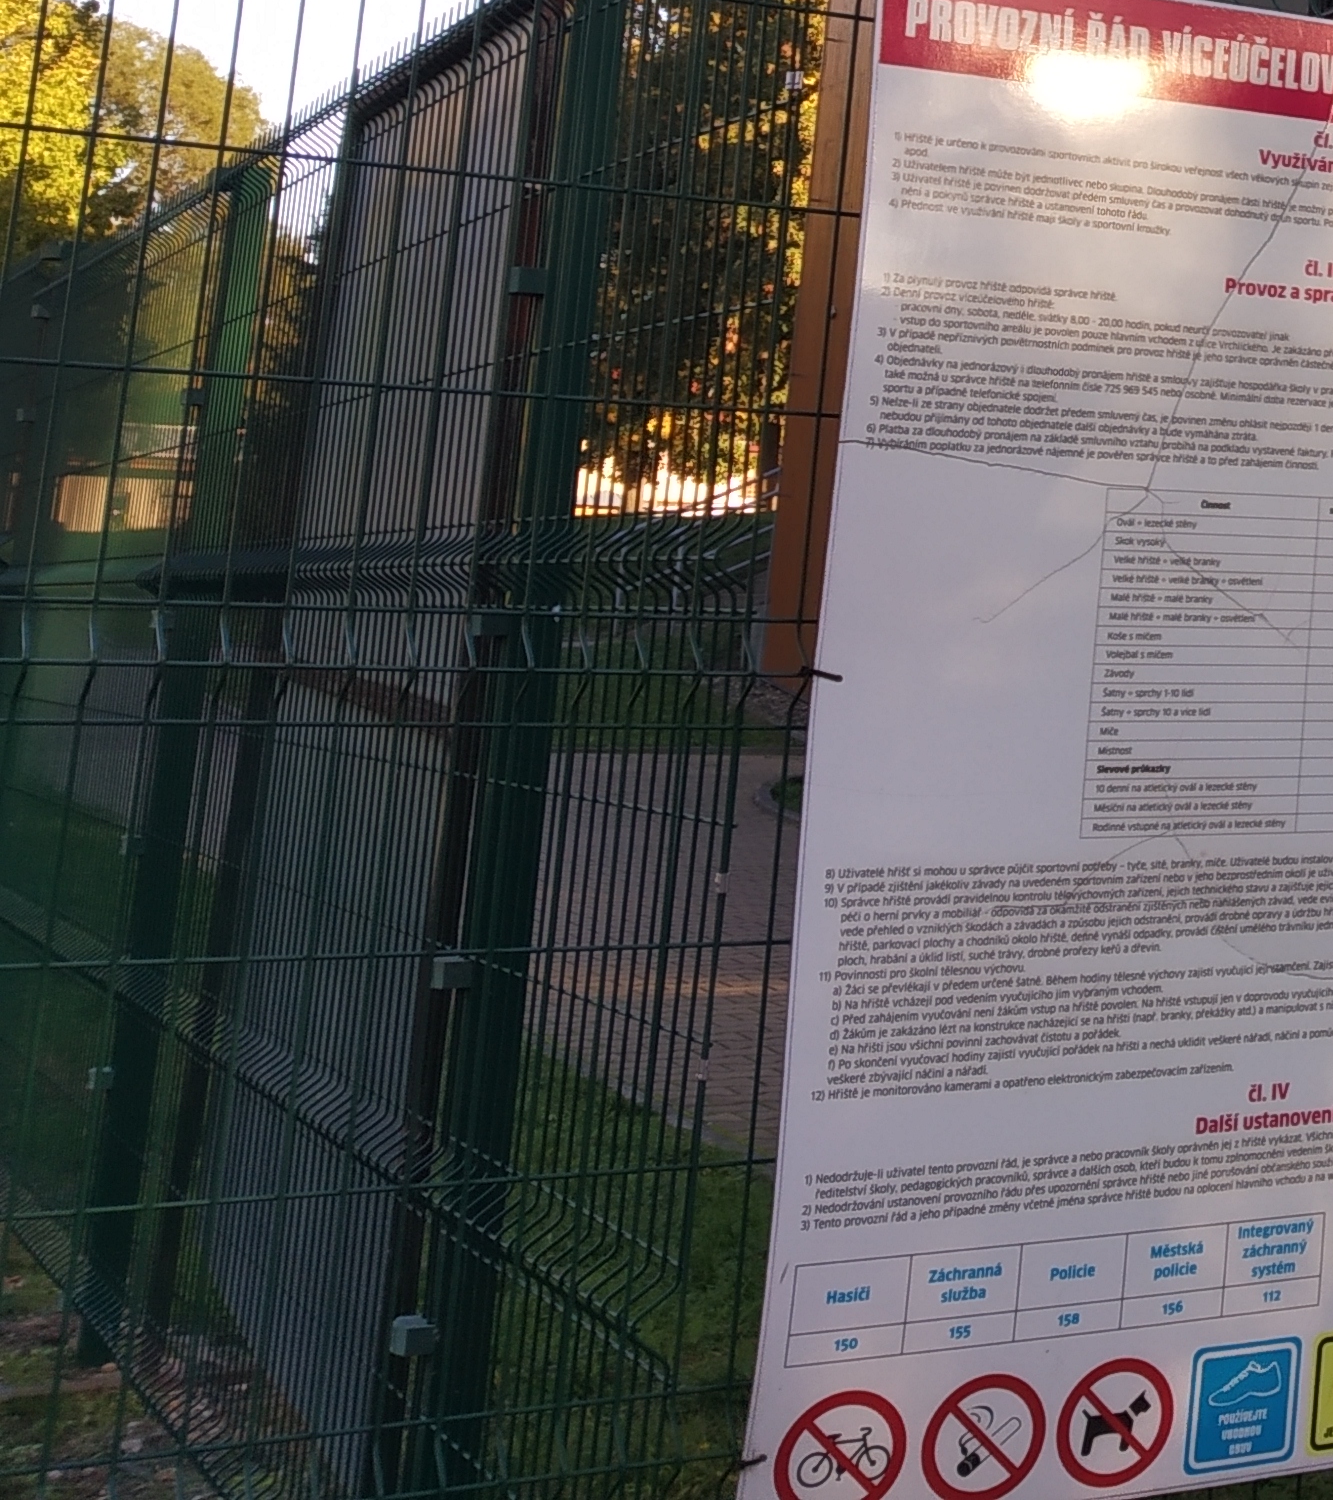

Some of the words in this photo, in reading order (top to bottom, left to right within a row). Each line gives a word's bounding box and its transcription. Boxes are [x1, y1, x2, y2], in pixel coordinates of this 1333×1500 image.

[1087, 11, 1151, 58] ŘÁD
[1314, 132, 1333, 149] čl.
[1304, 258, 1323, 277] čl.
[1224, 278, 1286, 298] Provoz
[1289, 286, 1299, 299] a
[1103, 668, 1134, 679] Závody
[819, 971, 831, 982] 11)
[834, 969, 886, 980] Povinnosti
[889, 969, 906, 979] pro
[909, 965, 938, 978] školní
[940, 965, 981, 976] tělesnou
[983, 964, 1025, 975] výchovu.
[831, 999, 841, 1011] b)
[844, 999, 858, 1009] Na
[860, 997, 889, 1008] hřiště
[892, 995, 932, 1007] vcházejí
[934, 994, 953, 1006] pod
[955, 992, 997, 1004] vedením
[999, 989, 1053, 1003] vyučujícího
[1054, 988, 1070, 1000] jím
[1072, 986, 1118, 999] vybraným
[1120, 984, 1163, 995] vchodem.
[828, 1044, 838, 1056] e)
[840, 1044, 855, 1054] Na
[857, 1041, 883, 1053] hřišti
[885, 1042, 906, 1053] jsou
[909, 1038, 943, 1050] všichni
[945, 1035, 982, 1049] povinni
[984, 1033, 1038, 1046] zachovávat
[1040, 1032, 1071, 1042] čistotu
[1073, 1032, 1079, 1040] a
[1081, 1027, 1120, 1040] pořádek.
[811, 1089, 825, 1101] 12)
[827, 1087, 858, 1099] Hřiště
[859, 1087, 870, 1099] je
[872, 1082, 941, 1096] monitorováno
[943, 1078, 991, 1091] kamerami
[993, 1080, 1000, 1088] a
[1002, 1076, 1045, 1089] opatřeno
[1047, 1070, 1113, 1085] elektronickým
[1115, 1065, 1187, 1080] zabezpečovacím
[1189, 1061, 1233, 1075] zařízením.
[1248, 1083, 1267, 1102] čl.
[1271, 1081, 1290, 1100] IV
[1195, 1112, 1239, 1134] Další
[1237, 1217, 1314, 1239] Integrovaný
[1150, 1240, 1203, 1259] Městská
[1241, 1238, 1307, 1258] záchranný
[928, 1261, 1002, 1283] Záchranná
[1049, 1263, 1095, 1281] Policie
[1153, 1261, 1197, 1281] policie
[1251, 1260, 1295, 1279] systém
[826, 1285, 870, 1304] Hasiči
[940, 1285, 986, 1303] služba
[1262, 1289, 1281, 1302] 112
[1162, 1299, 1183, 1315] 156
[1057, 1312, 1079, 1327] 158
[949, 1324, 971, 1339] 155
[834, 1337, 858, 1352] 150
[1324, 1428, 1333, 1438] JE
